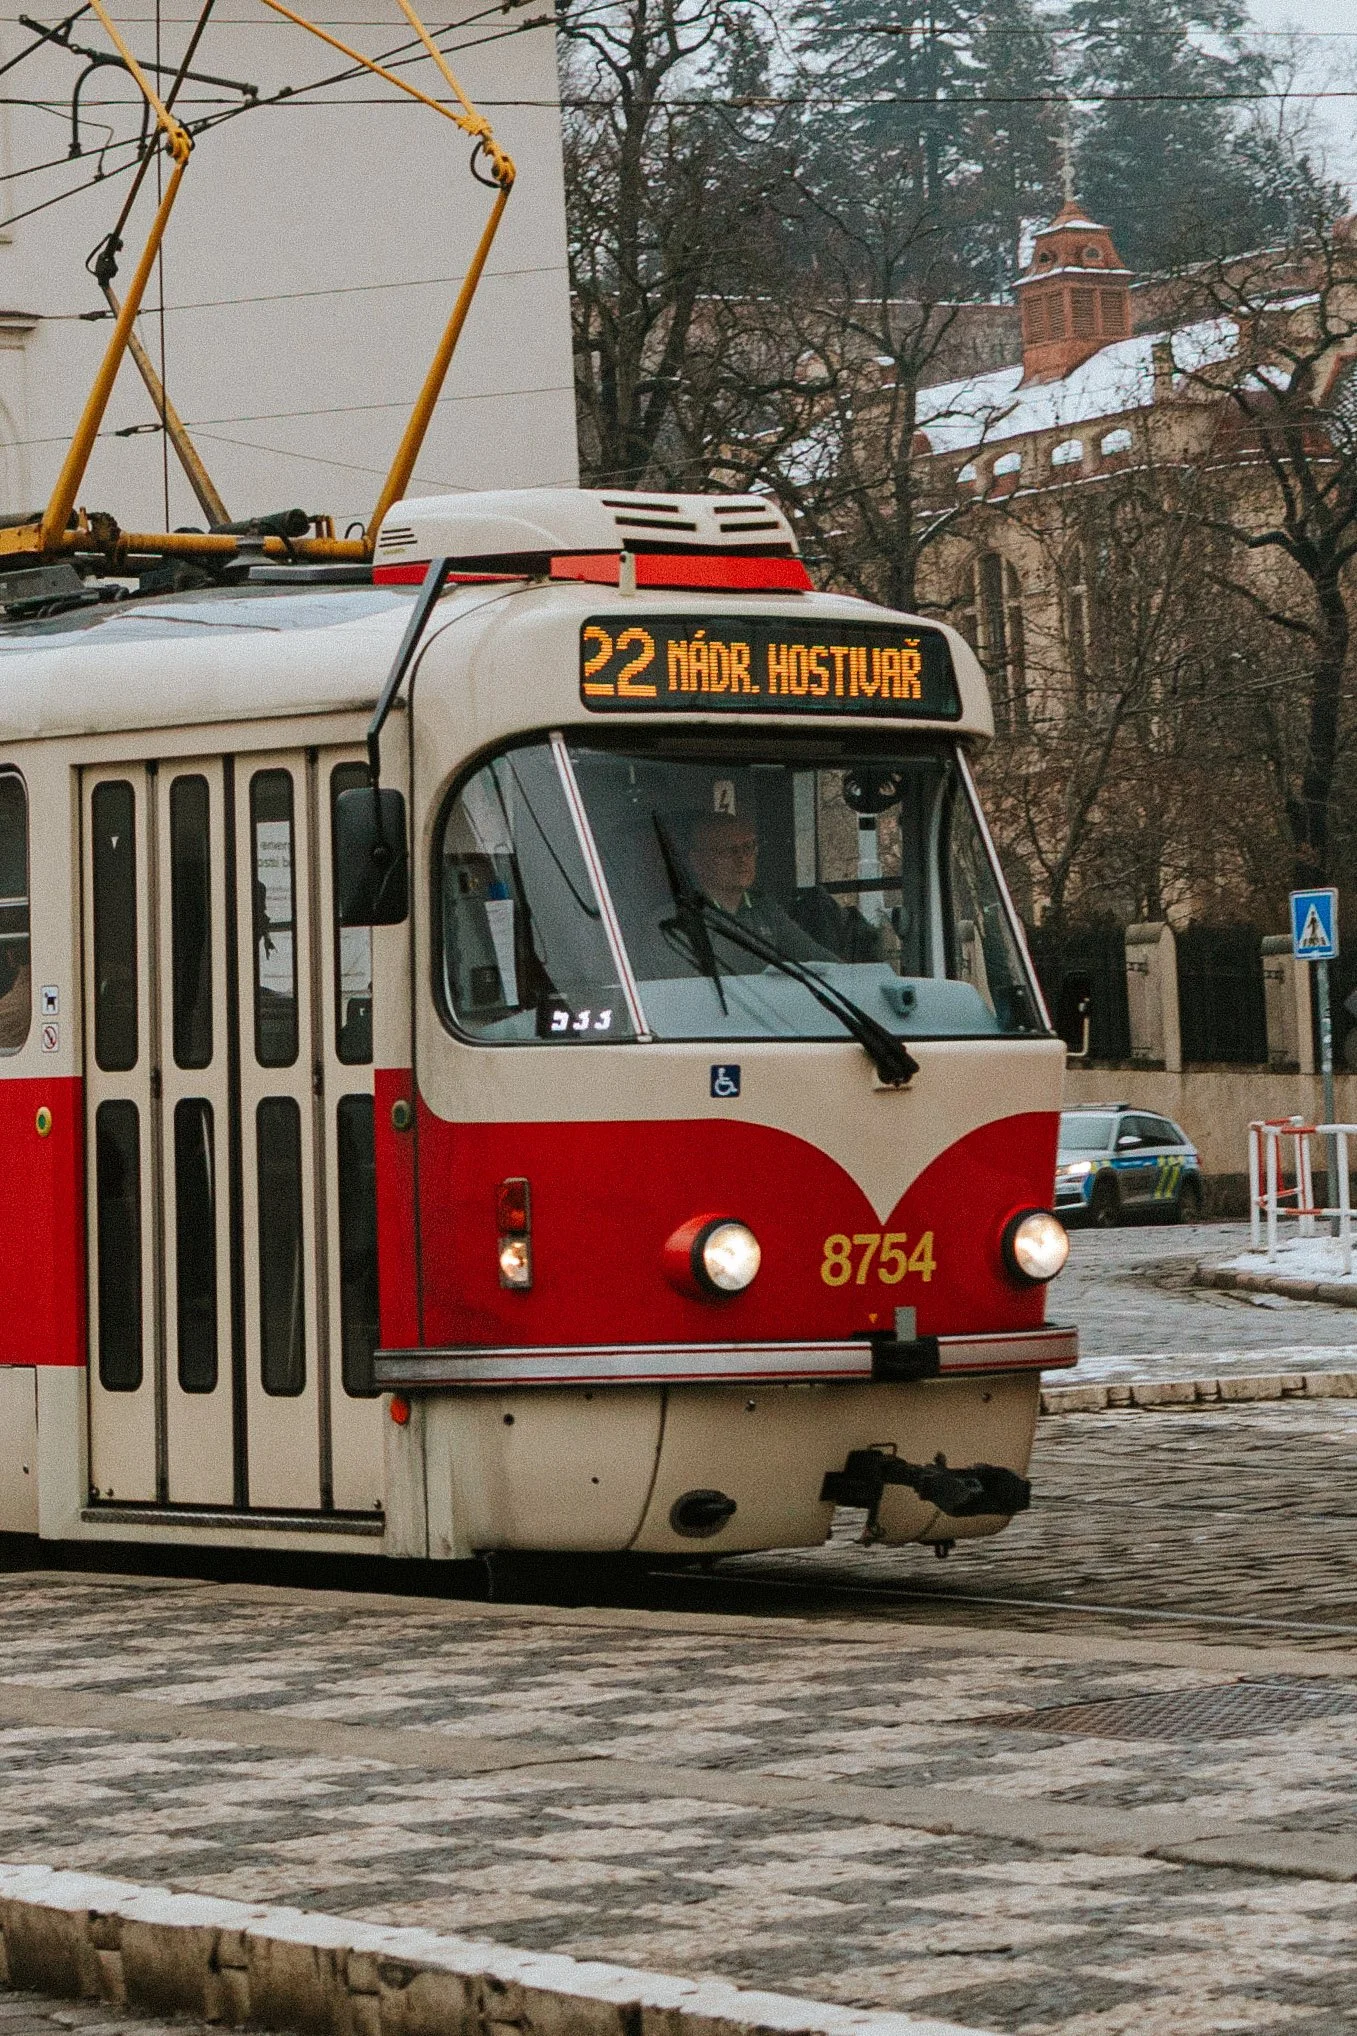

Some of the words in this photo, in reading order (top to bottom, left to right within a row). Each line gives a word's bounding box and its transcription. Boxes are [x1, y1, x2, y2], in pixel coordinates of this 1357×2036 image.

[584, 626, 657, 696] 22
[667, 629, 760, 694] NÁDR.
[768, 638, 922, 698] HOSTIVAŘ
[821, 1231, 937, 1286] 8754
